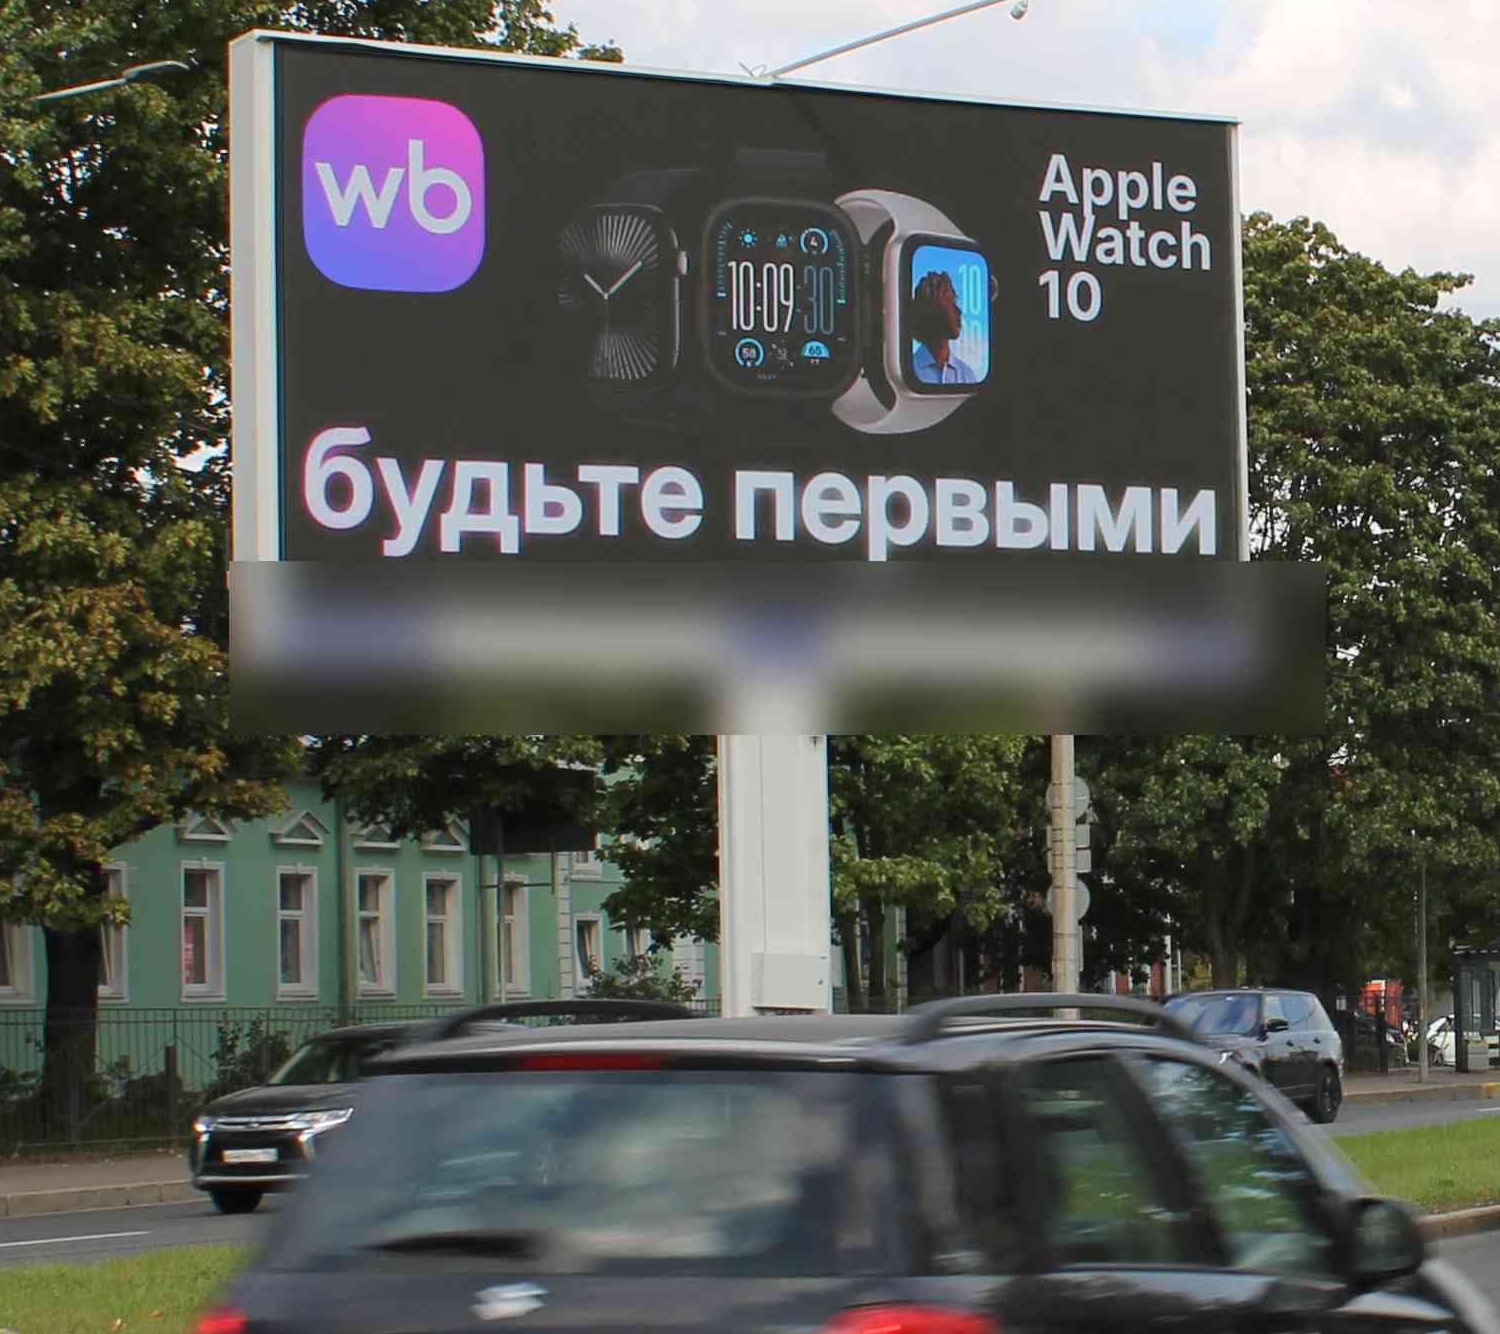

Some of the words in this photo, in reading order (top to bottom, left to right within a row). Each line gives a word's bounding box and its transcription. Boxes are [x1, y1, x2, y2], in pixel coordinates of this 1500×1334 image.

[314, 139, 472, 235] wb
[1038, 153, 1198, 221] Apple
[1038, 210, 1212, 272] Watch
[1038, 269, 1103, 323] 10
[303, 426, 705, 558] будьте
[734, 469, 1218, 563] первыми
